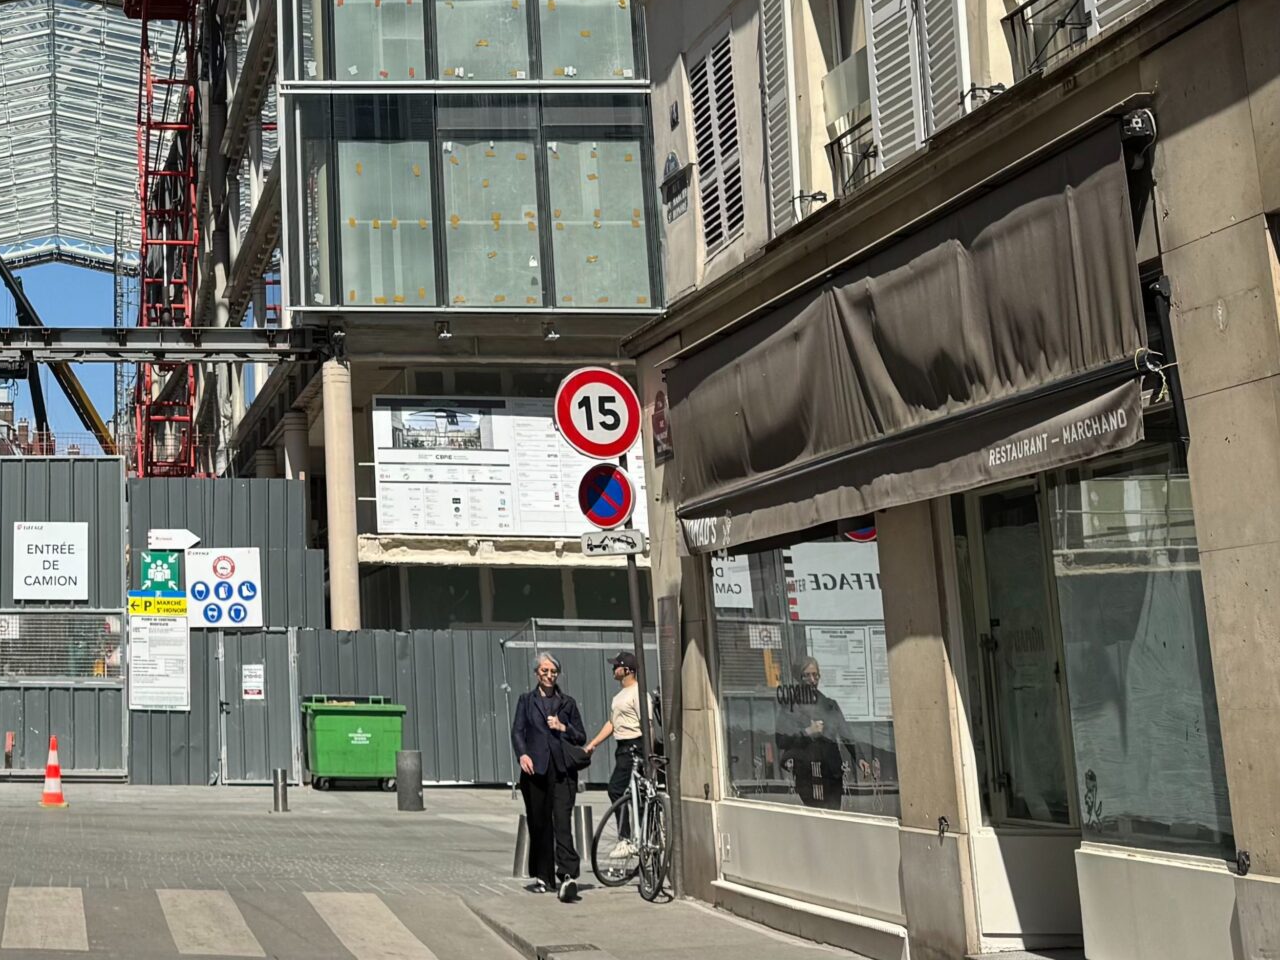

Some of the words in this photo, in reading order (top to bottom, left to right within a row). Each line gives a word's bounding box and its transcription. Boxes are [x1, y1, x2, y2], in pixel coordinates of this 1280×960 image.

[577, 395, 621, 431] 15
[989, 433, 1048, 467] RESTAURANT
[1062, 408, 1128, 445] MARCHAND
[26, 541, 76, 555] ENTRÉE
[42, 559, 60, 571] DE
[23, 575, 78, 587] CAMION
[143, 600, 153, 612] P
